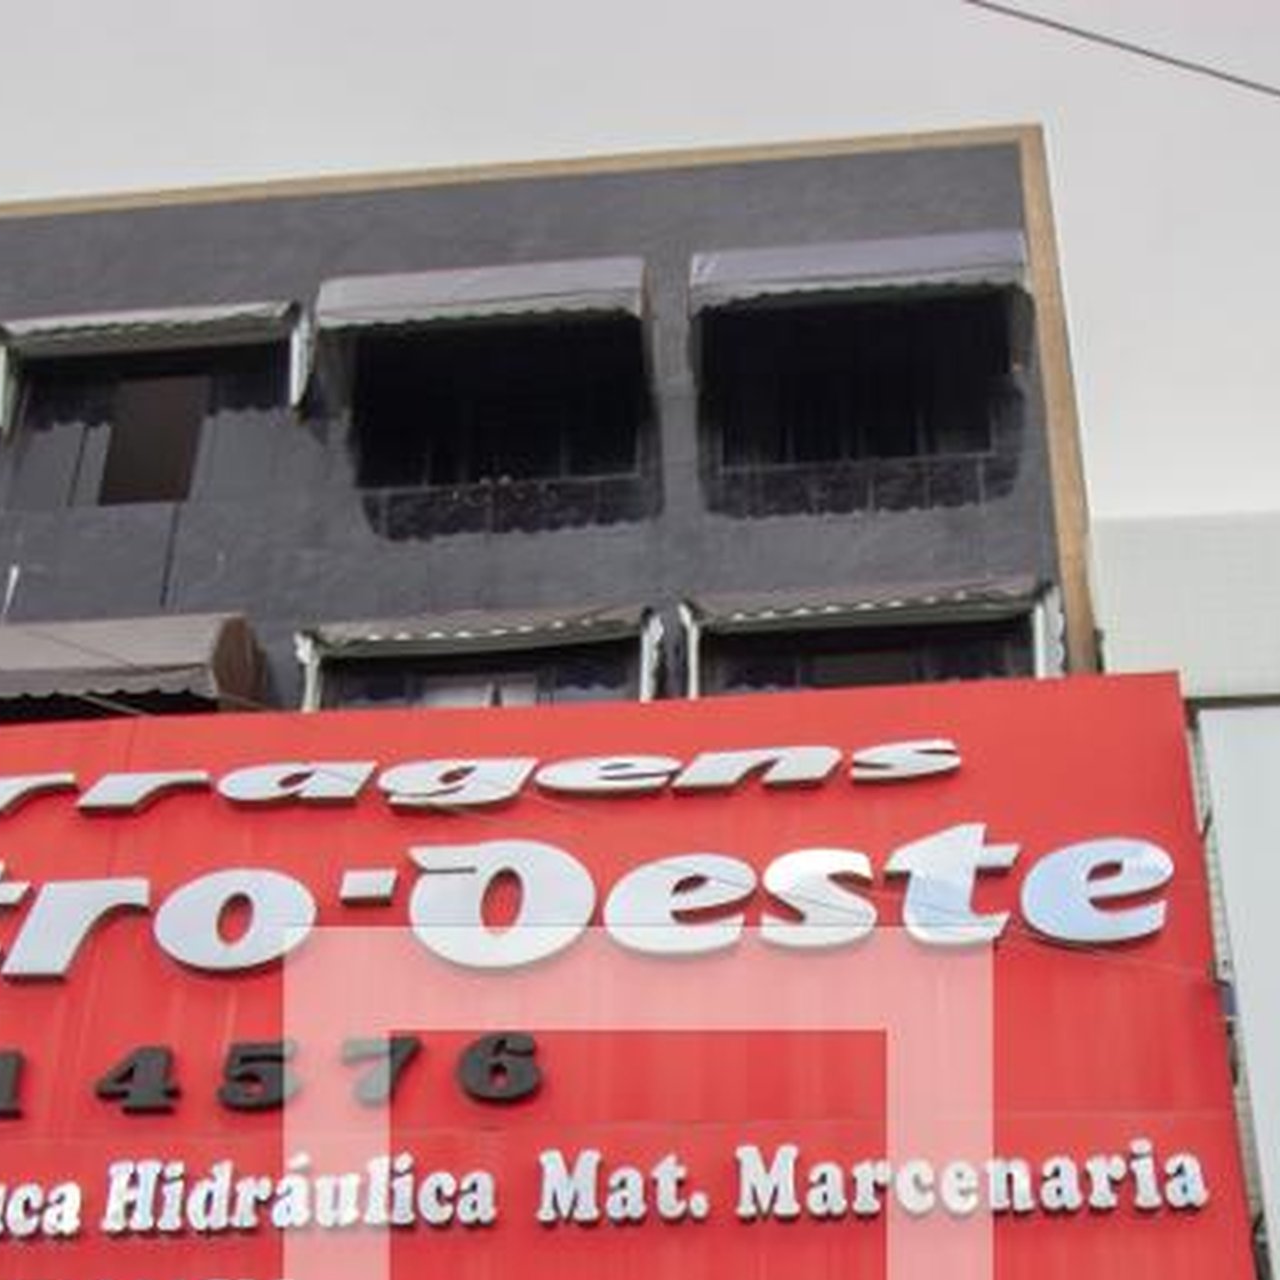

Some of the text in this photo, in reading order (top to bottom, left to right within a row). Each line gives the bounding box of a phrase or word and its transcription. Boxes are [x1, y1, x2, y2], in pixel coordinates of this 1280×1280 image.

[101, 1150, 497, 1235] Hidráulica
[536, 1147, 711, 1225] Mat.
[735, 1138, 1210, 1224] Marcenaria
